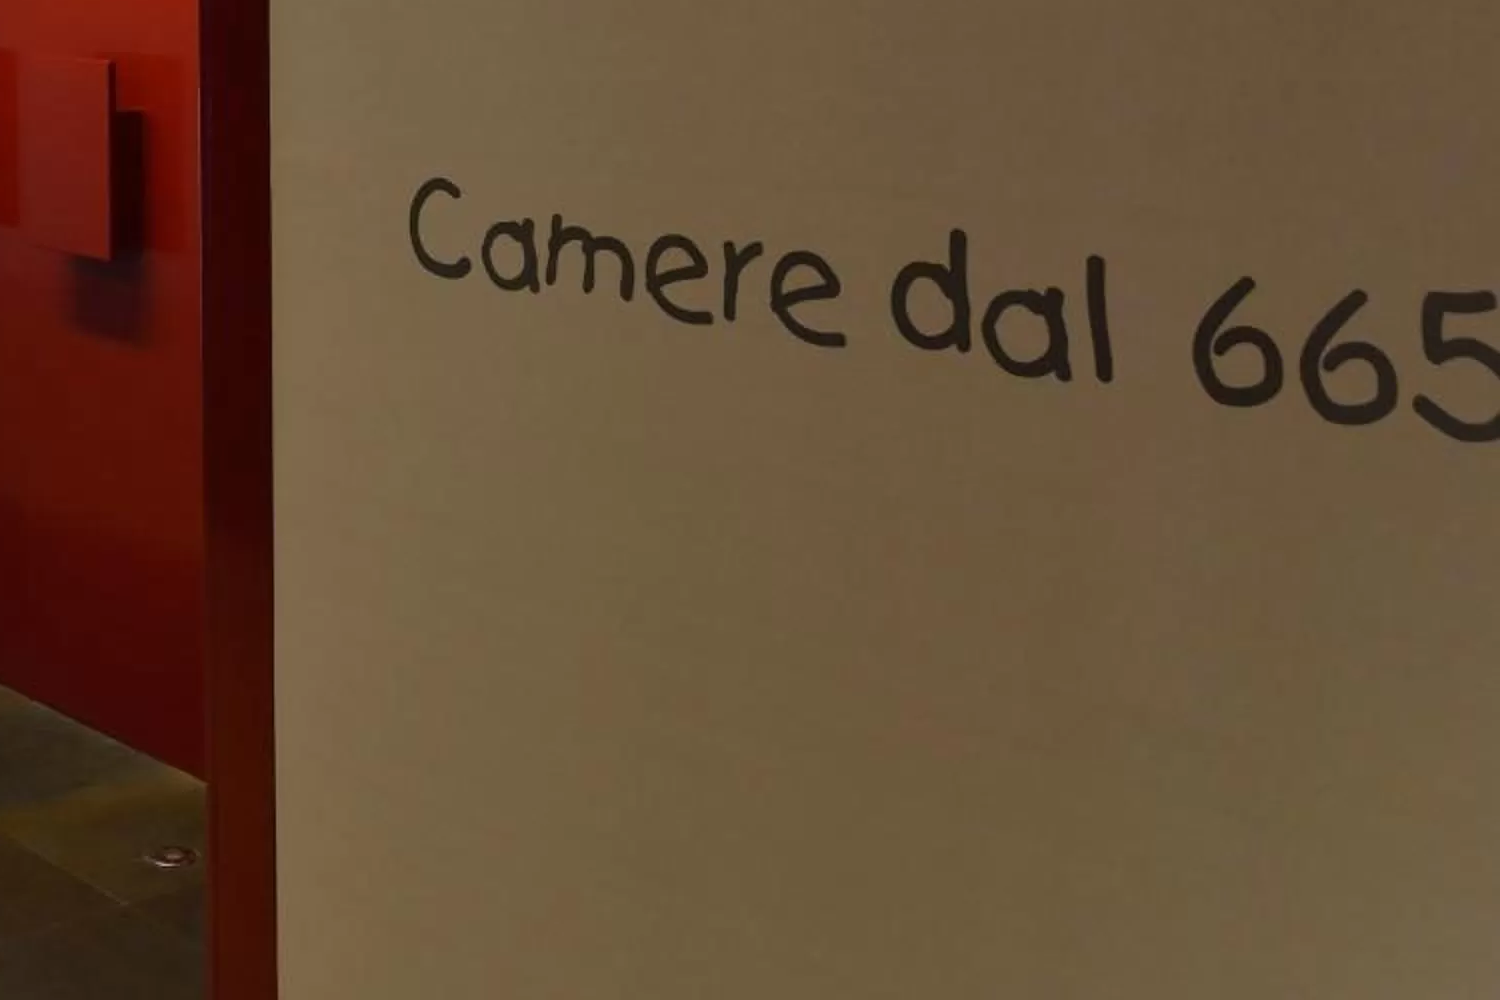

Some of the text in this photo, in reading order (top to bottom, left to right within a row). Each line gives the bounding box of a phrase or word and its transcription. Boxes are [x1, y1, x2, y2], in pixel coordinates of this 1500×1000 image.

[409, 177, 1500, 443] Camere dal 665
